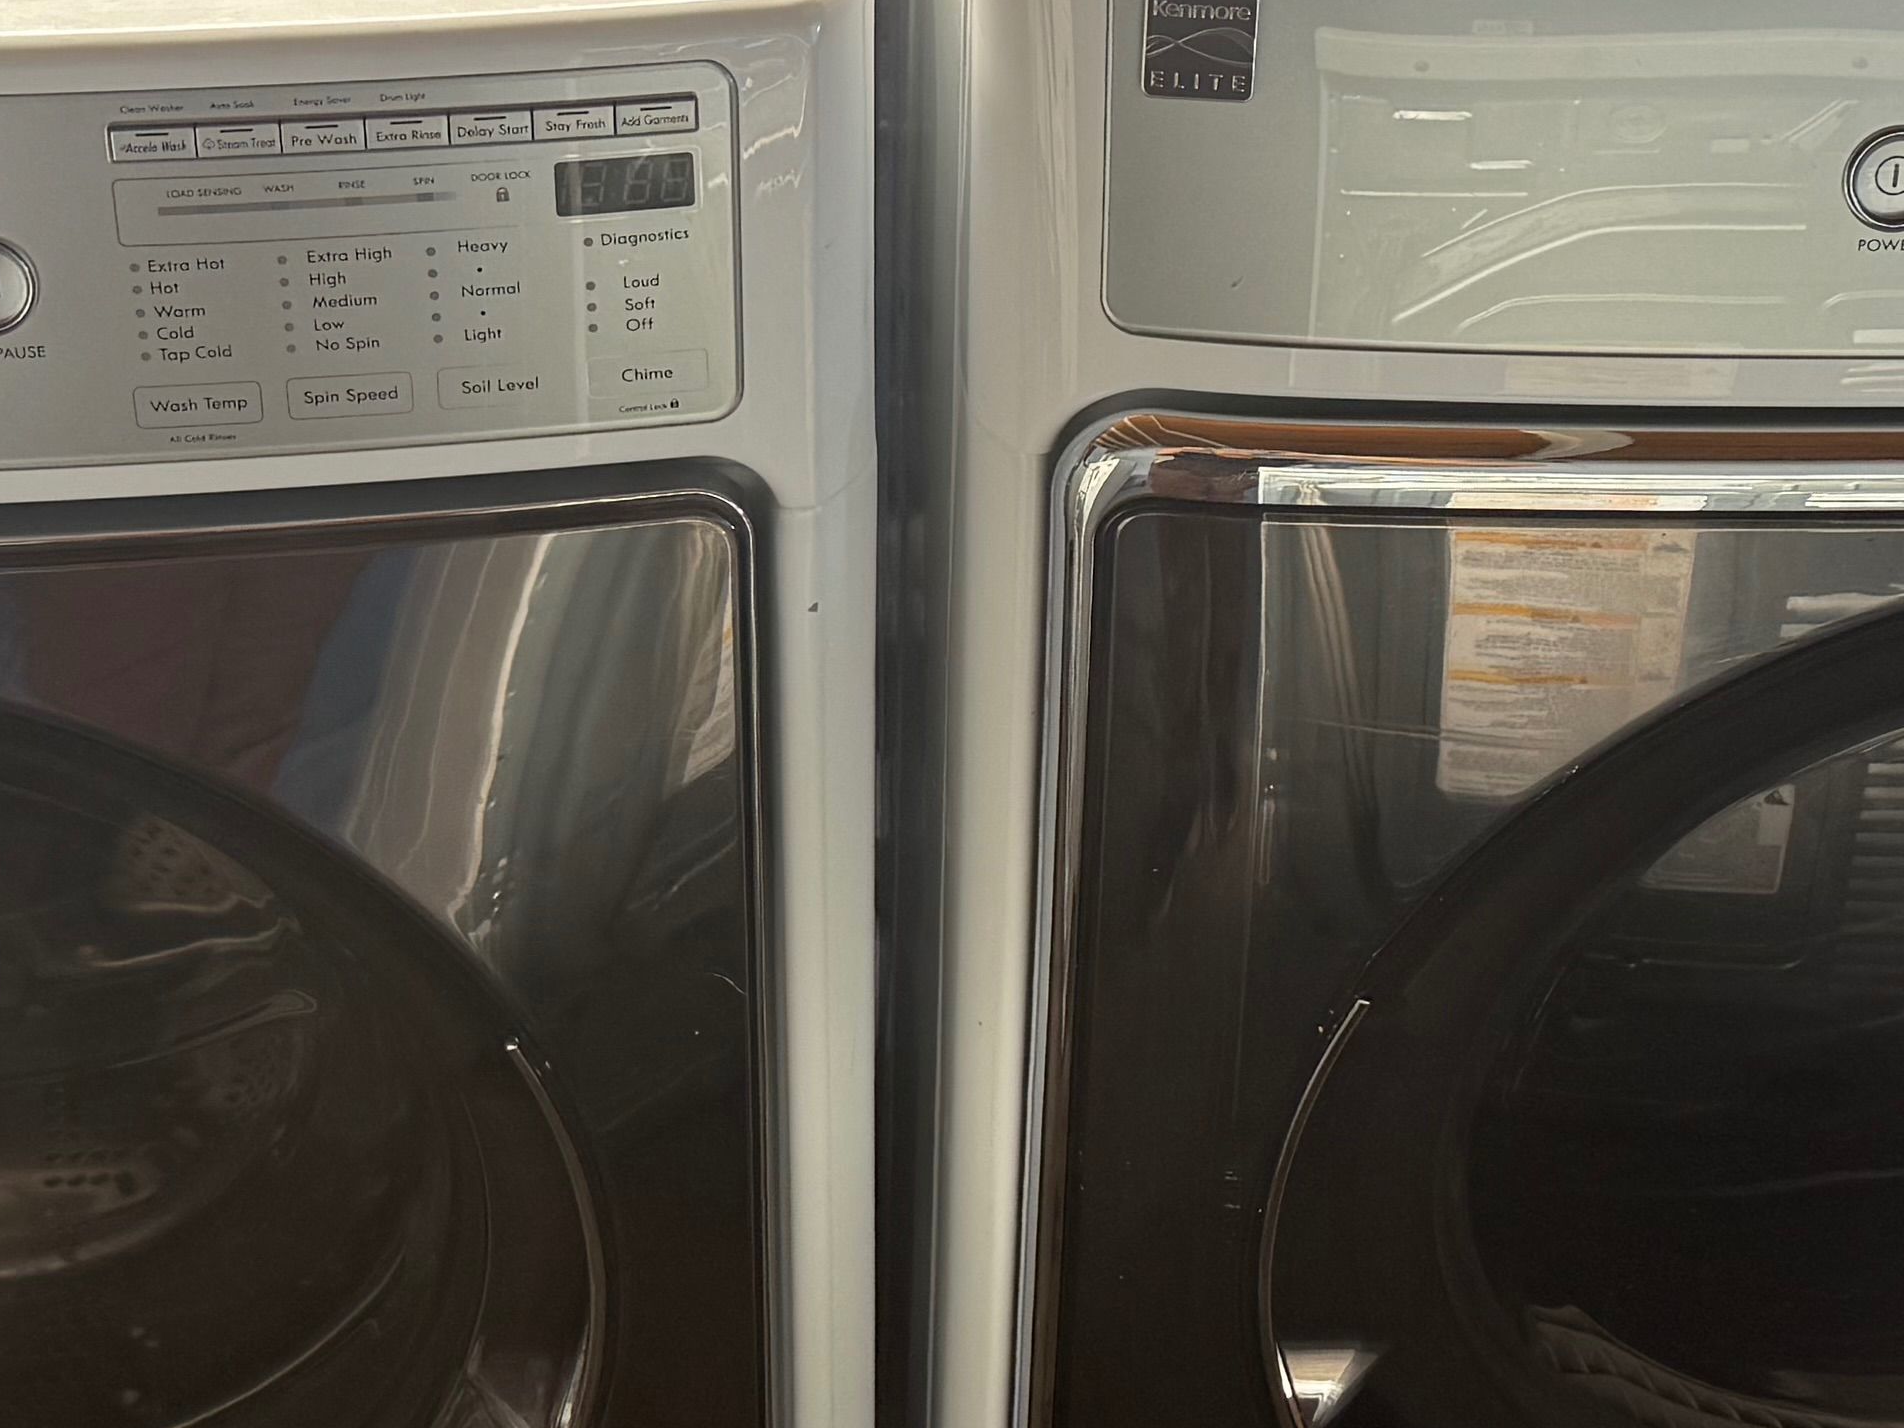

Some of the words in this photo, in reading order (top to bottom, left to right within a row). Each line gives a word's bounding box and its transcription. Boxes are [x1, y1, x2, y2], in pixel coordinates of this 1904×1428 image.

[1153, 0, 1251, 20] Kenmore
[1150, 70, 1246, 92] ELITE
[457, 126, 494, 138] Delay
[499, 123, 528, 135] Start
[546, 120, 571, 132] Stay
[291, 136, 311, 146] Pre
[318, 133, 357, 146] Wash
[376, 130, 407, 141] Extra
[412, 129, 441, 140] Rinse
[263, 184, 294, 193] WASH
[338, 180, 366, 189] RINSE
[601, 228, 689, 248] Diagnostics
[458, 240, 508, 254] Heavy
[307, 250, 349, 263] Extra
[355, 247, 392, 262] High
[148, 260, 190, 273] Extra
[197, 258, 225, 270] Hot
[309, 272, 346, 288] High
[624, 274, 660, 288] Loud
[151, 282, 179, 294] Hot
[462, 282, 520, 297] Normal
[312, 294, 378, 308] Medium
[625, 298, 656, 311] Soft
[154, 305, 206, 318] Warm
[314, 319, 345, 331] Low
[626, 318, 654, 331] Off
[157, 327, 194, 340] Cold
[464, 328, 502, 344] Light
[316, 339, 340, 351] No
[346, 336, 380, 351] Spin
[159, 349, 190, 364] Tap
[196, 345, 232, 359] Cold
[622, 367, 674, 382] Chime
[462, 380, 490, 394] Soil
[498, 376, 539, 392] Level
[304, 390, 339, 406] Spin
[346, 386, 398, 402] Speed
[150, 399, 197, 412] Wash
[204, 397, 248, 411] Temp
